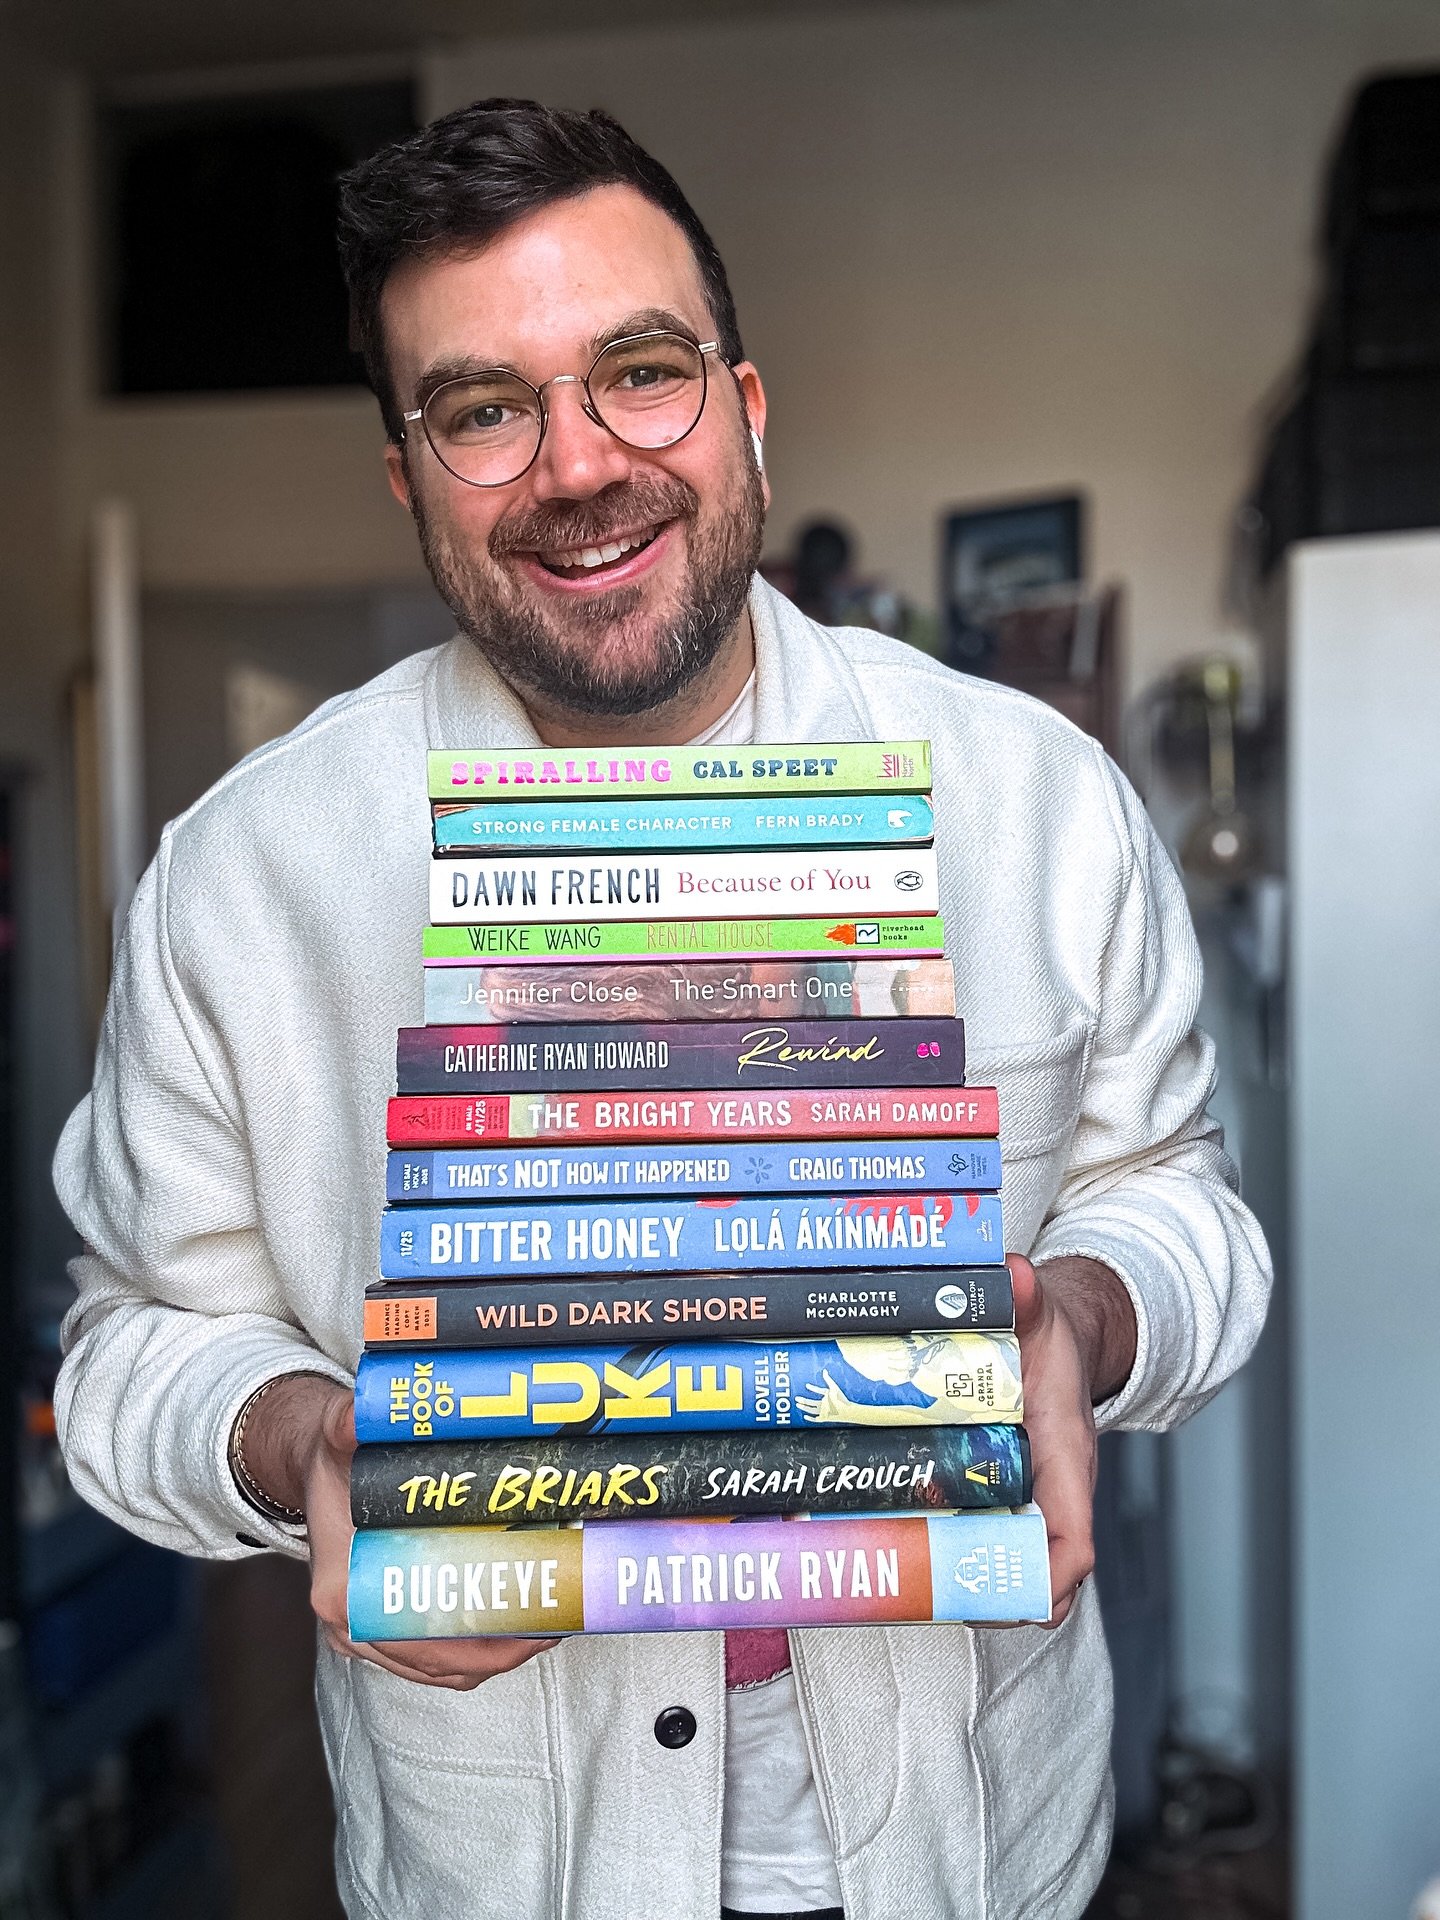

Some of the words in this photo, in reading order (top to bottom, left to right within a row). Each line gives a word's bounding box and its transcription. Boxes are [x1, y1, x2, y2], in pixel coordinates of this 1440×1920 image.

[451, 759, 672, 785] SPIRALLING
[693, 760, 743, 779] CAL
[752, 758, 838, 778] SPEET
[472, 820, 545, 834] STRONG
[551, 818, 620, 833] FEMALE
[625, 816, 731, 832] CHARACTER
[755, 815, 800, 829] FERN
[806, 813, 865, 828] BRADY
[451, 870, 536, 908] DAWN
[551, 867, 660, 905] FRENCH
[677, 870, 782, 894] Because
[789, 868, 817, 892] of
[822, 868, 871, 891] You
[467, 926, 530, 952] WEIKE
[544, 925, 601, 950] WANG
[647, 923, 708, 949] RENTAL
[717, 922, 774, 948] HOUSE
[882, 924, 925, 932] riverhead
[459, 982, 563, 1005] Jennifer
[570, 981, 639, 1004] Close
[670, 978, 714, 1001] The
[722, 977, 798, 1000] Smart
[806, 976, 853, 999] One
[444, 1043, 537, 1073] CATHERINE
[544, 1042, 587, 1071] RYAN
[594, 1040, 669, 1070] HOWARD
[736, 1026, 886, 1075] Rewind
[474, 1100, 486, 1136] 4/1/25
[527, 1102, 580, 1130] THE
[595, 1100, 695, 1128] BRIGHT
[706, 1099, 792, 1127] YEARS
[811, 1101, 881, 1123] SARAH
[892, 1100, 979, 1123] DAMOFF
[403, 1163, 411, 1180] SALE
[448, 1163, 508, 1188] THAT'S
[514, 1159, 562, 1190] NOT
[566, 1161, 608, 1184] HOW
[614, 1161, 629, 1184] IT
[635, 1159, 730, 1184] HAPPENED
[789, 1156, 844, 1181] CRAIG
[848, 1155, 926, 1180] THOMAS
[403, 1180, 411, 1191] ON
[400, 1230, 413, 1257] 11/25
[430, 1219, 553, 1264] BITTER
[567, 1216, 685, 1260] HONEY
[796, 1205, 947, 1250] ÁKÍNMÁDÉ
[476, 1303, 558, 1329] WILD
[568, 1299, 653, 1325] DARK
[663, 1296, 767, 1322] SHORE
[806, 1306, 900, 1319] McCONAGHY
[807, 1290, 897, 1304] CHARLOTTE
[968, 1280, 978, 1322] FLATIRON
[978, 1287, 986, 1315] BOOKS
[390, 1377, 410, 1424] THE
[412, 1361, 434, 1436] BOOK
[434, 1380, 454, 1417] OF
[460, 1359, 743, 1425] LUKE
[755, 1355, 770, 1422] LOVELL
[774, 1351, 790, 1424] HOLDER
[976, 1367, 985, 1402] GRAND
[986, 1362, 994, 1406] CENTRAL
[398, 1471, 477, 1514] THE
[487, 1463, 669, 1513] BRIARS
[701, 1465, 805, 1500] SARAH
[816, 1459, 936, 1493] CROUCH
[617, 1552, 783, 1605] PATRICK
[800, 1548, 900, 1600] RYAN
[993, 1544, 1008, 1594] RANDOM
[1008, 1550, 1024, 1588] HOUSE
[383, 1559, 559, 1615] BUCKEYE
